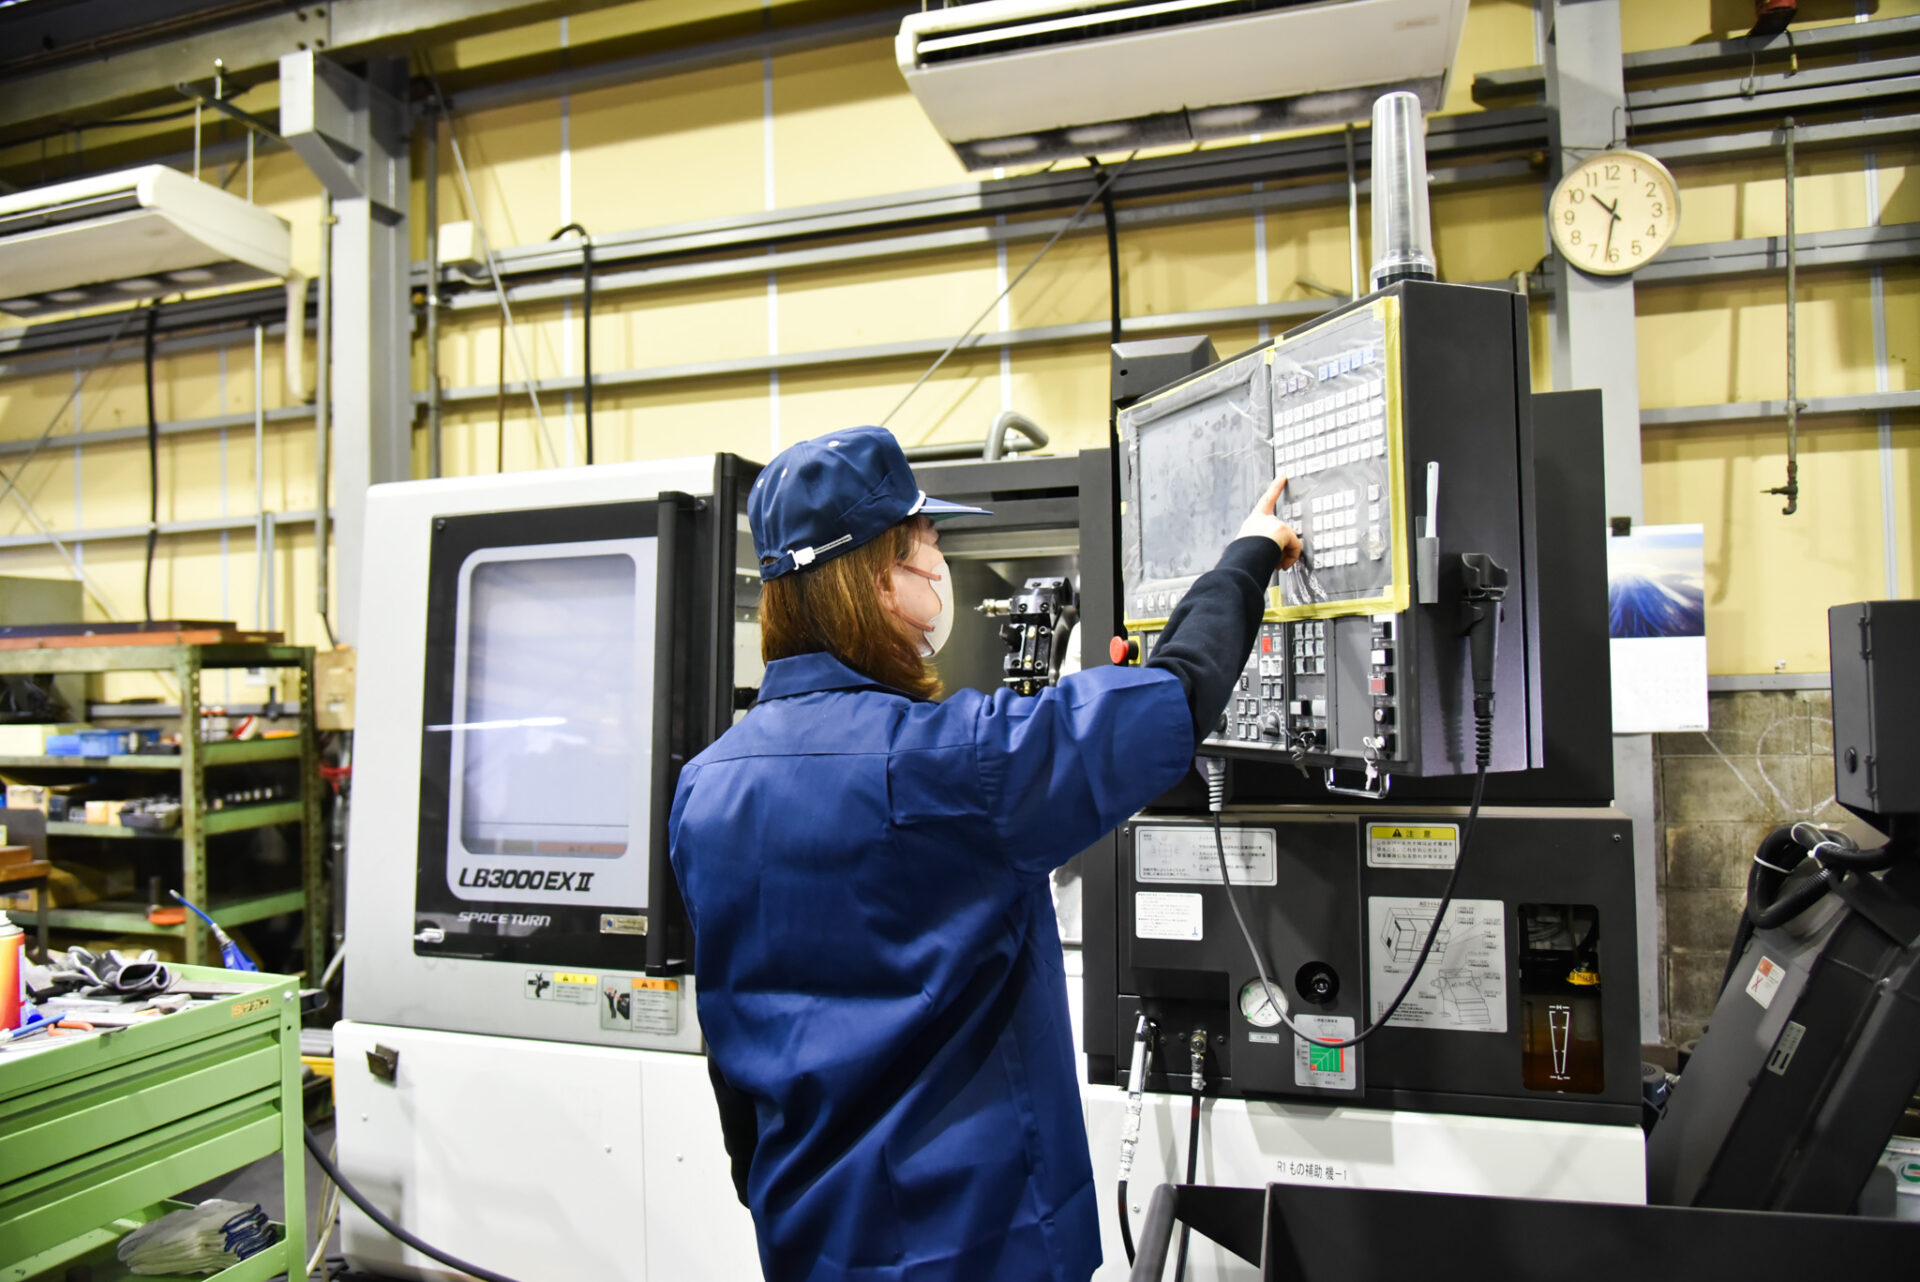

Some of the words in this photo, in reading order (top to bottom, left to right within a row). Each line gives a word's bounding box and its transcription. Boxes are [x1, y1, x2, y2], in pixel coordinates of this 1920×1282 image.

[1585, 172, 1598, 188] 11
[1605, 164, 1621, 181] 12
[1632, 168, 1637, 183] 1
[1569, 188, 1585, 204] 10
[1645, 181, 1656, 198] 2
[1564, 210, 1575, 225] 9
[1651, 202, 1663, 218] 3
[1570, 230, 1582, 245] 8
[1646, 224, 1657, 239] 4
[1588, 243, 1598, 259] 7
[1608, 248, 1620, 263] 6
[1631, 240, 1642, 255] 5
[457, 911, 510, 925] SPACE
[510, 913, 552, 927] TURN
